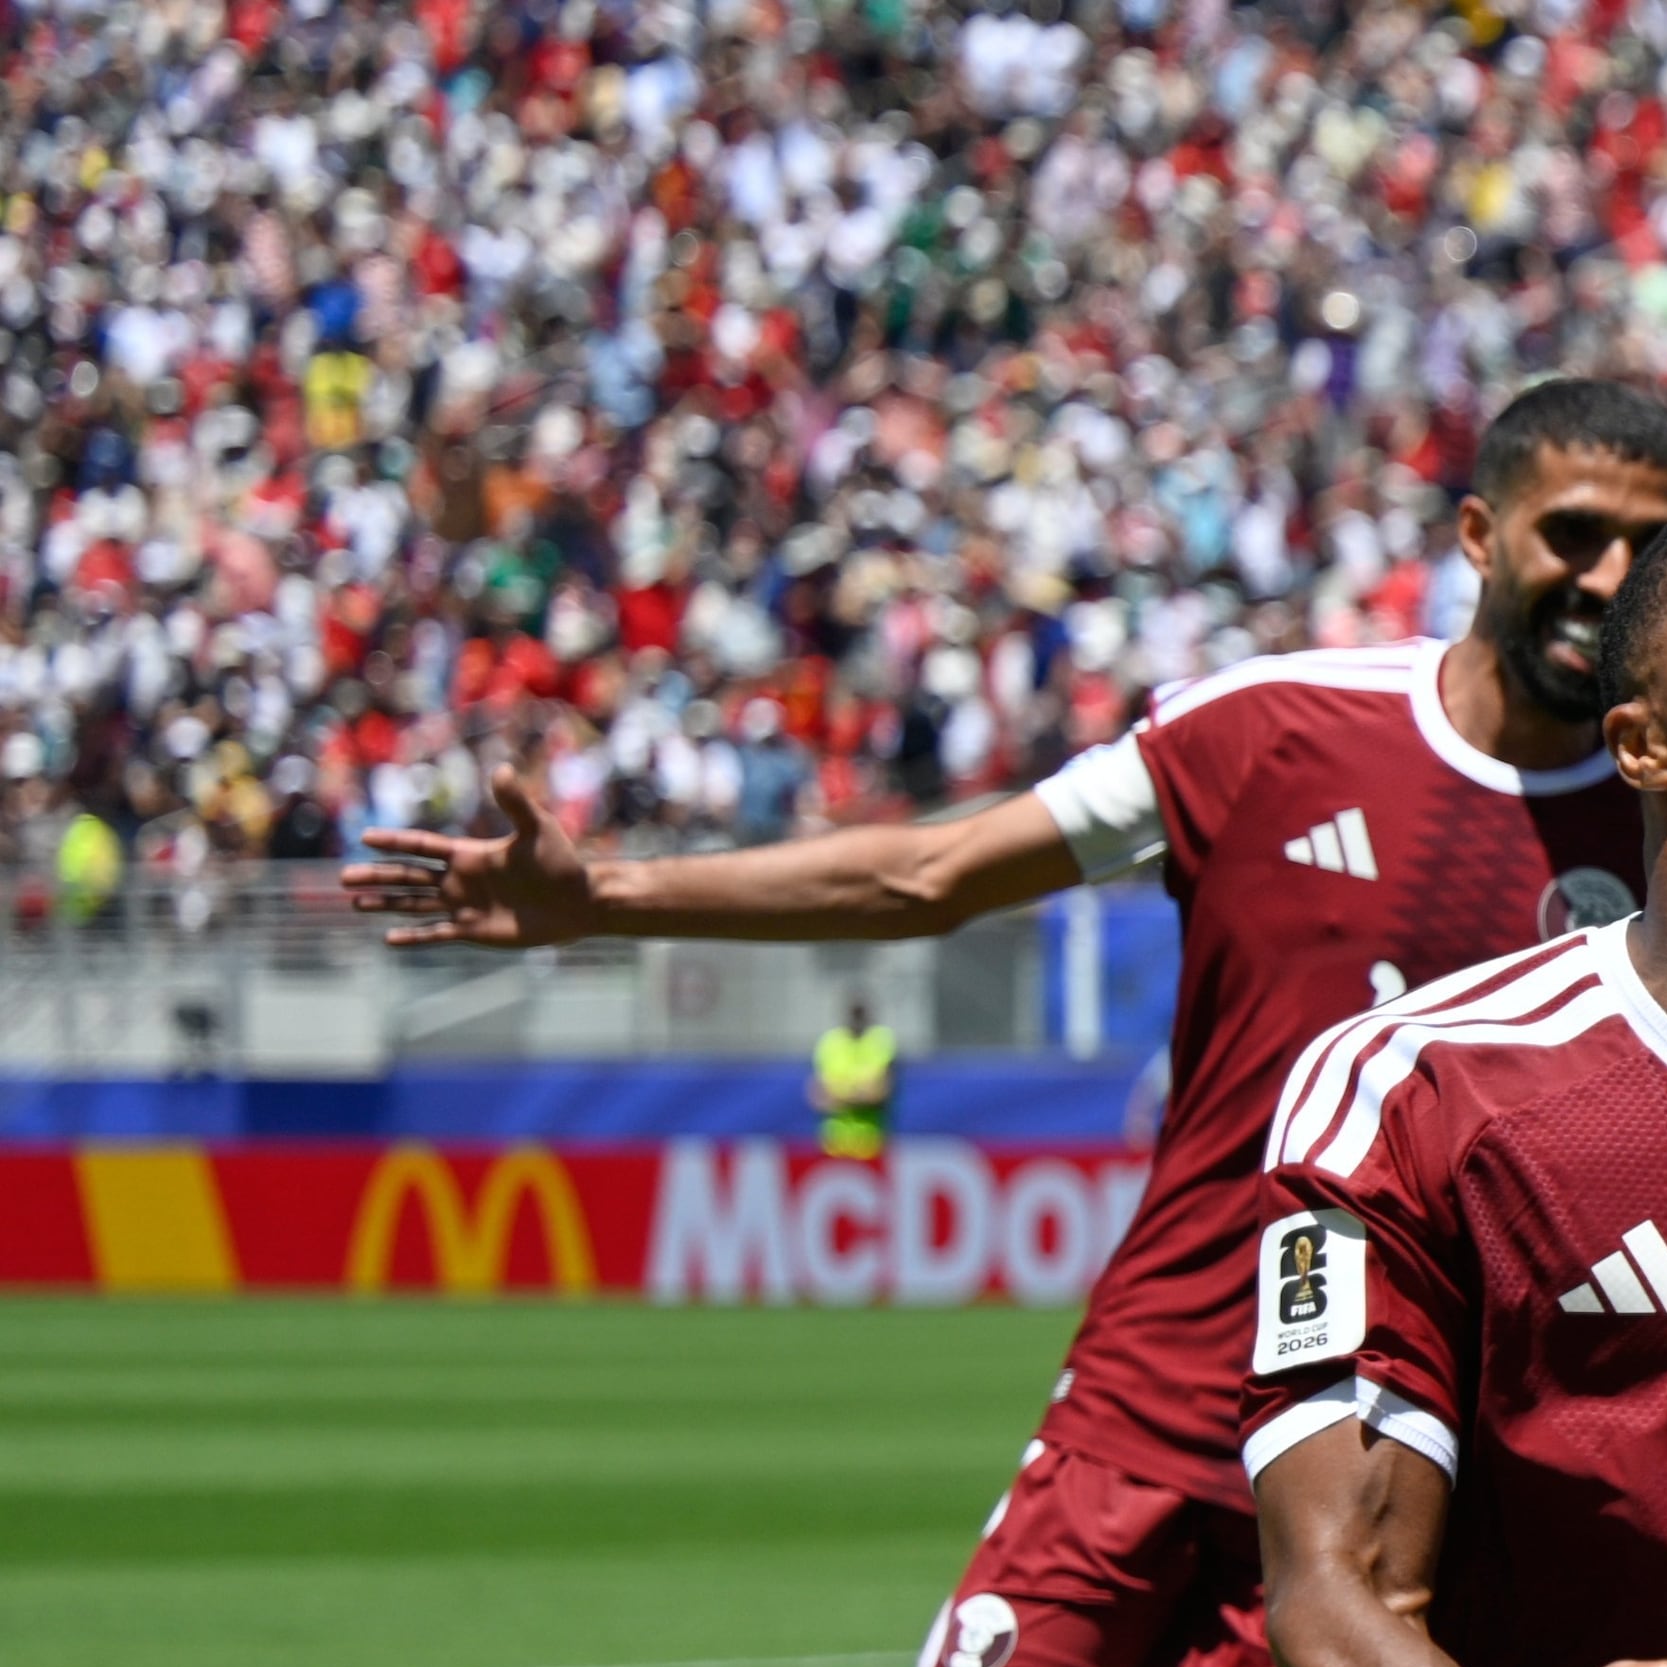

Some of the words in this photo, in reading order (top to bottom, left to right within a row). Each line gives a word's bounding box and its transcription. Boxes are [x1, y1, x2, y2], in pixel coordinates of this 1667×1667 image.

[1290, 1302, 1317, 1317] FIFA
[1278, 1326, 1310, 1339] WORLD
[1277, 1332, 1328, 1356] 2026
